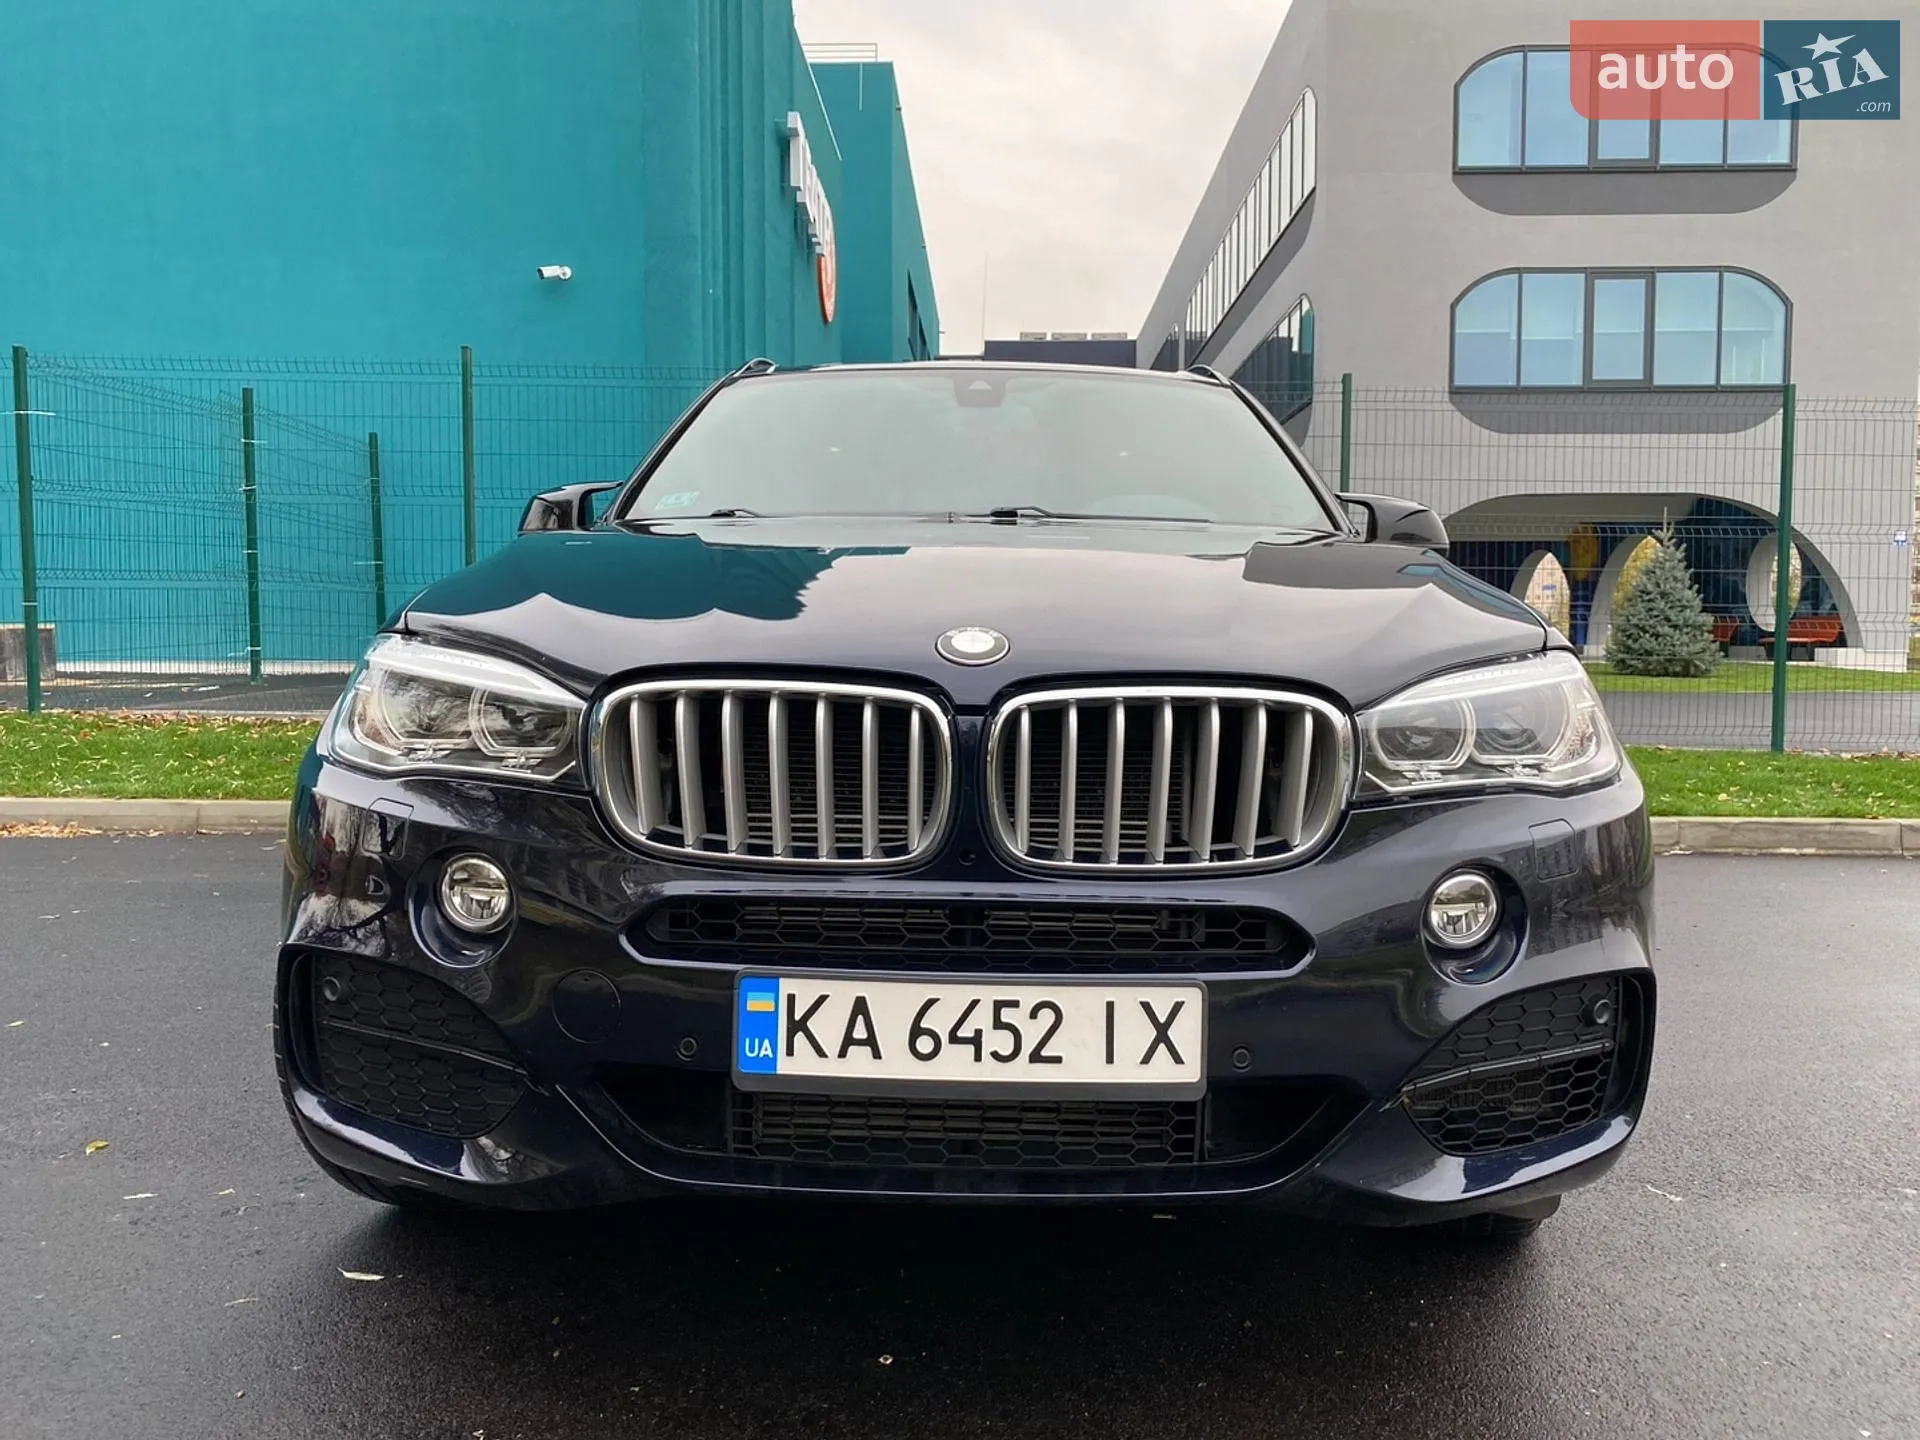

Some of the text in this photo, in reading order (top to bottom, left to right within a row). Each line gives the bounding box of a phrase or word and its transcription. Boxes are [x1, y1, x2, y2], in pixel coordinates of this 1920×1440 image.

[744, 1037, 774, 1059] UA
[785, 993, 1187, 1066] KA 6452 IX
